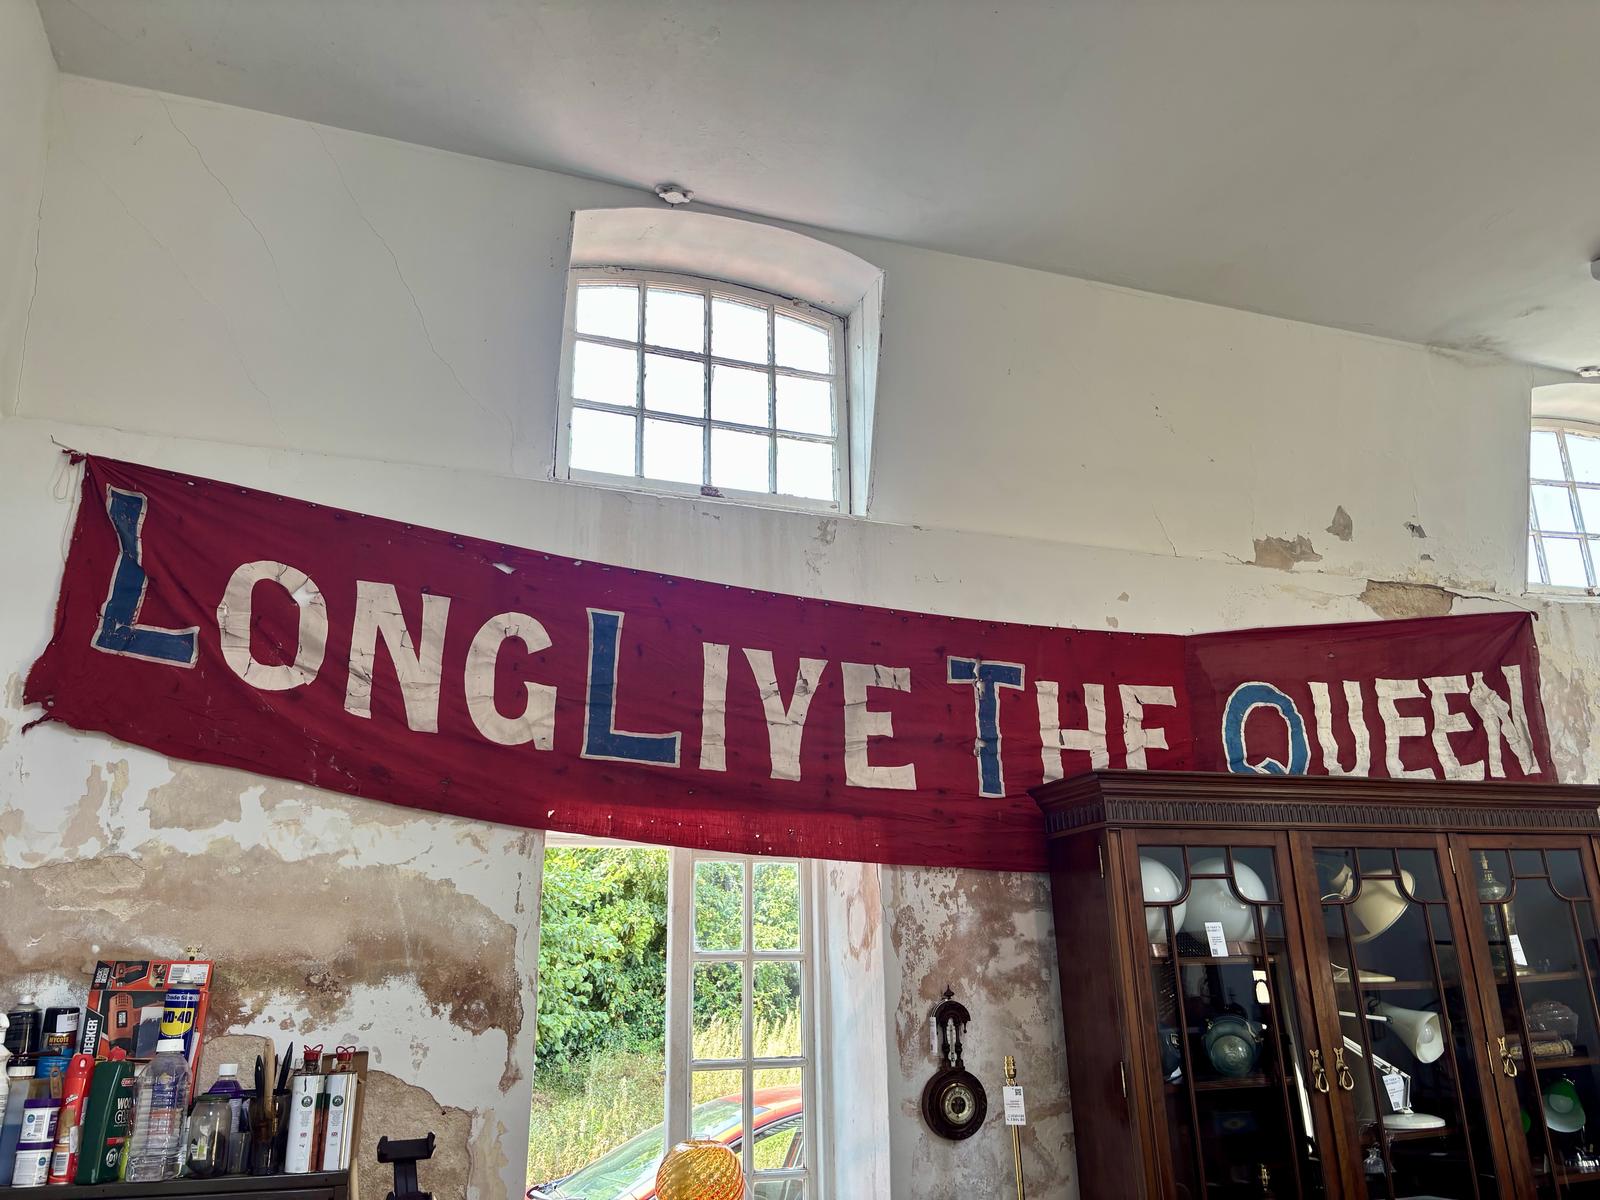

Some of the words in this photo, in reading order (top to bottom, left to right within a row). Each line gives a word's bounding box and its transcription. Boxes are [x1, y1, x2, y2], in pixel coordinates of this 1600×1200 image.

[91, 484, 557, 751] LONG
[947, 655, 1177, 798] THE
[1220, 664, 1541, 781] QUEEN
[83, 1018, 98, 1054] DECKER
